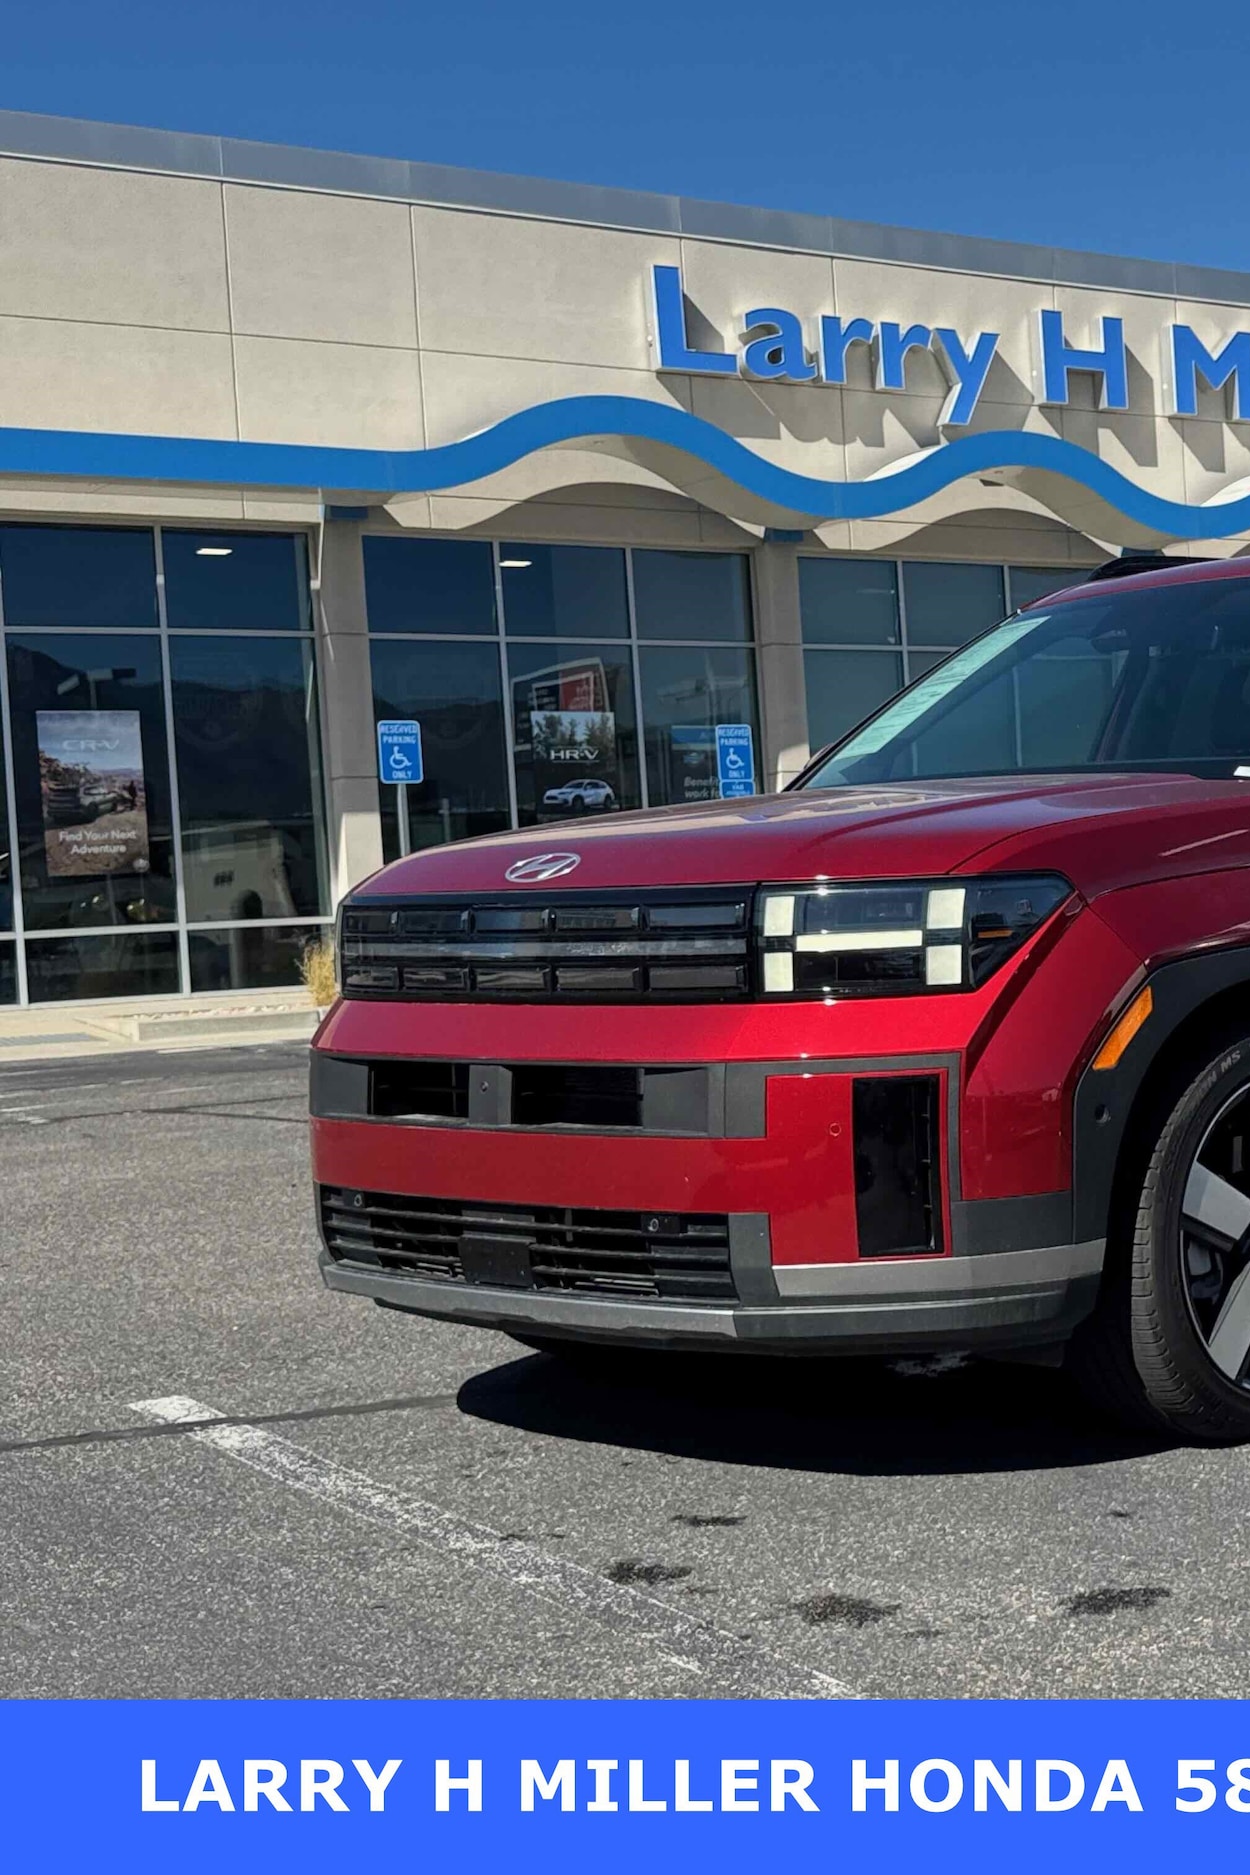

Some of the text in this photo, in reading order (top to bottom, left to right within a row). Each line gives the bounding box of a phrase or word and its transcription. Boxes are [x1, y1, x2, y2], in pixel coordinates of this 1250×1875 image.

[654, 266, 997, 426] Larry
[1040, 309, 1129, 410] H
[382, 735, 417, 744] PARKING
[720, 738, 749, 746] PARKING
[550, 749, 599, 760] HR-V
[392, 770, 412, 779] ONLY
[728, 770, 745, 778] ONLY
[59, 829, 137, 842] Find Your Next
[70, 844, 127, 855] Adventure
